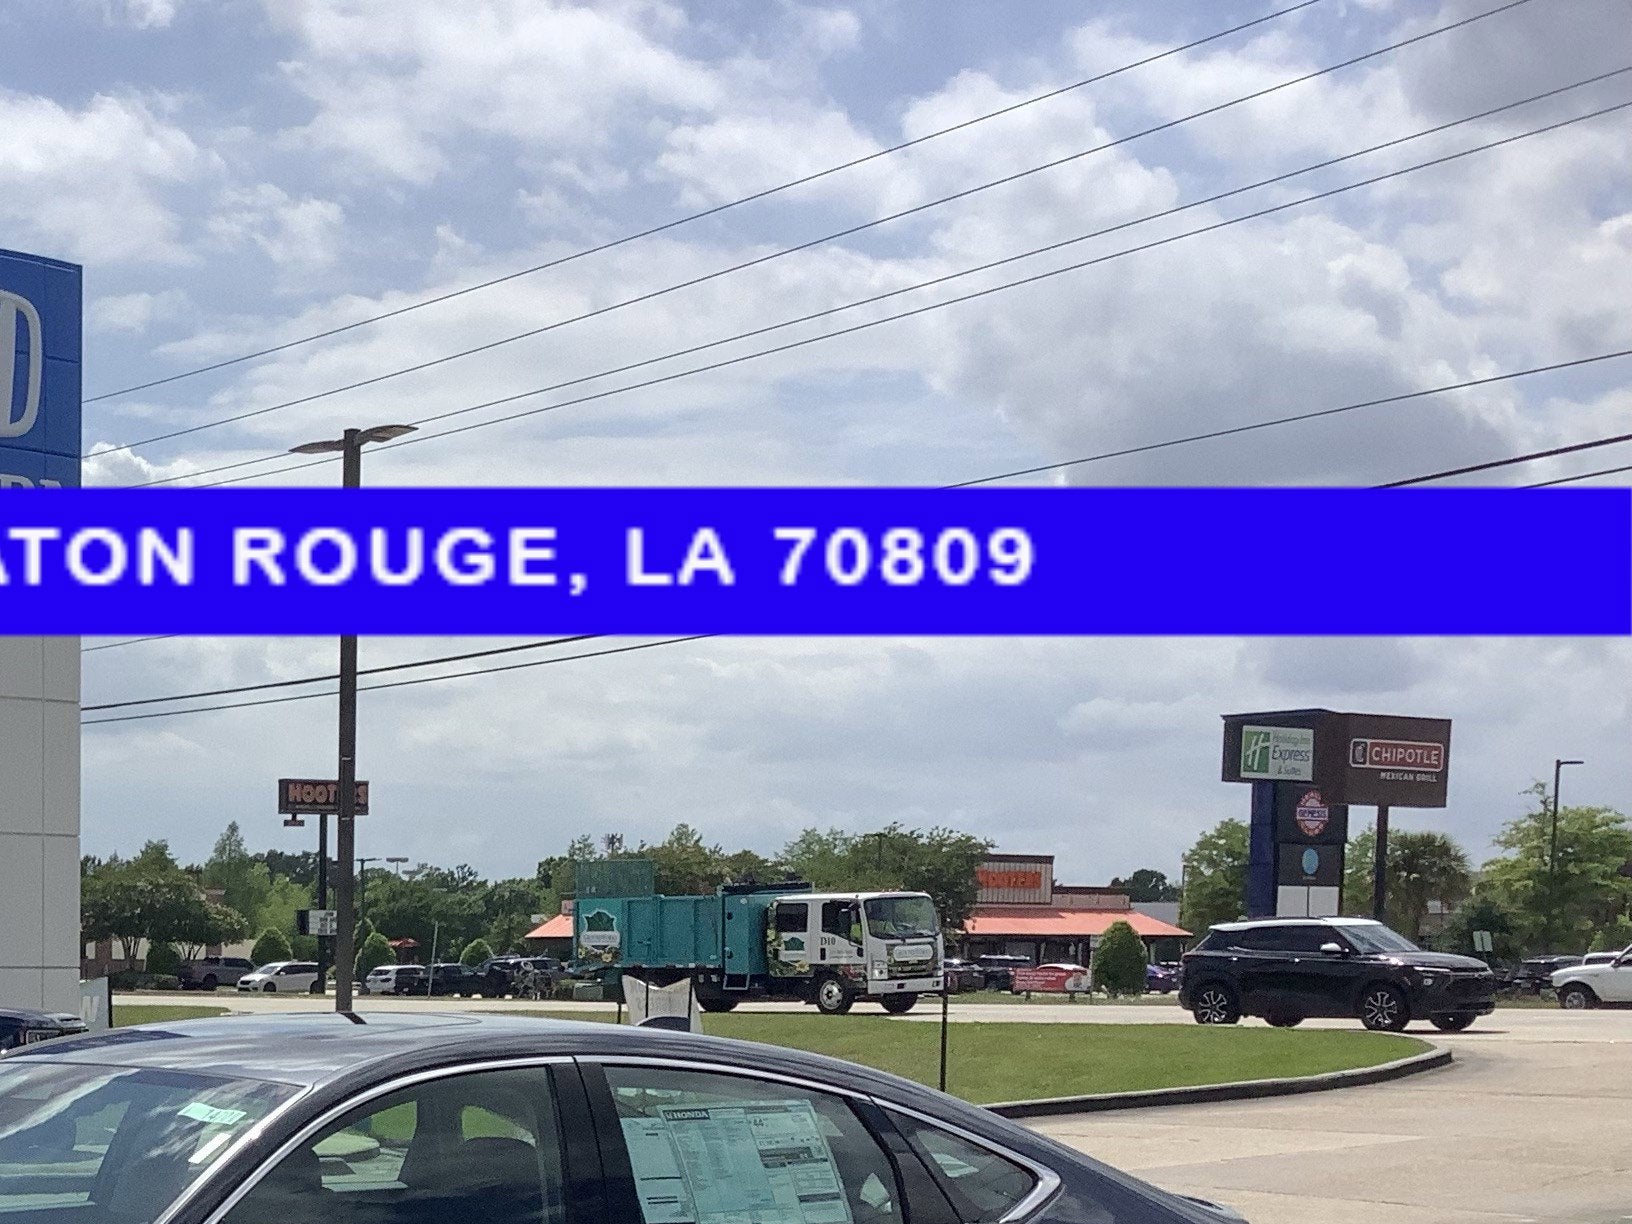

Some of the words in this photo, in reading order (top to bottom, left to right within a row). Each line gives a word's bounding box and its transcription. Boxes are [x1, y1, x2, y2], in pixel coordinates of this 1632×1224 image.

[1371, 746, 1439, 765] CHIPOTLE
[820, 936, 837, 946] D10
[672, 1110, 709, 1119] HONDA
